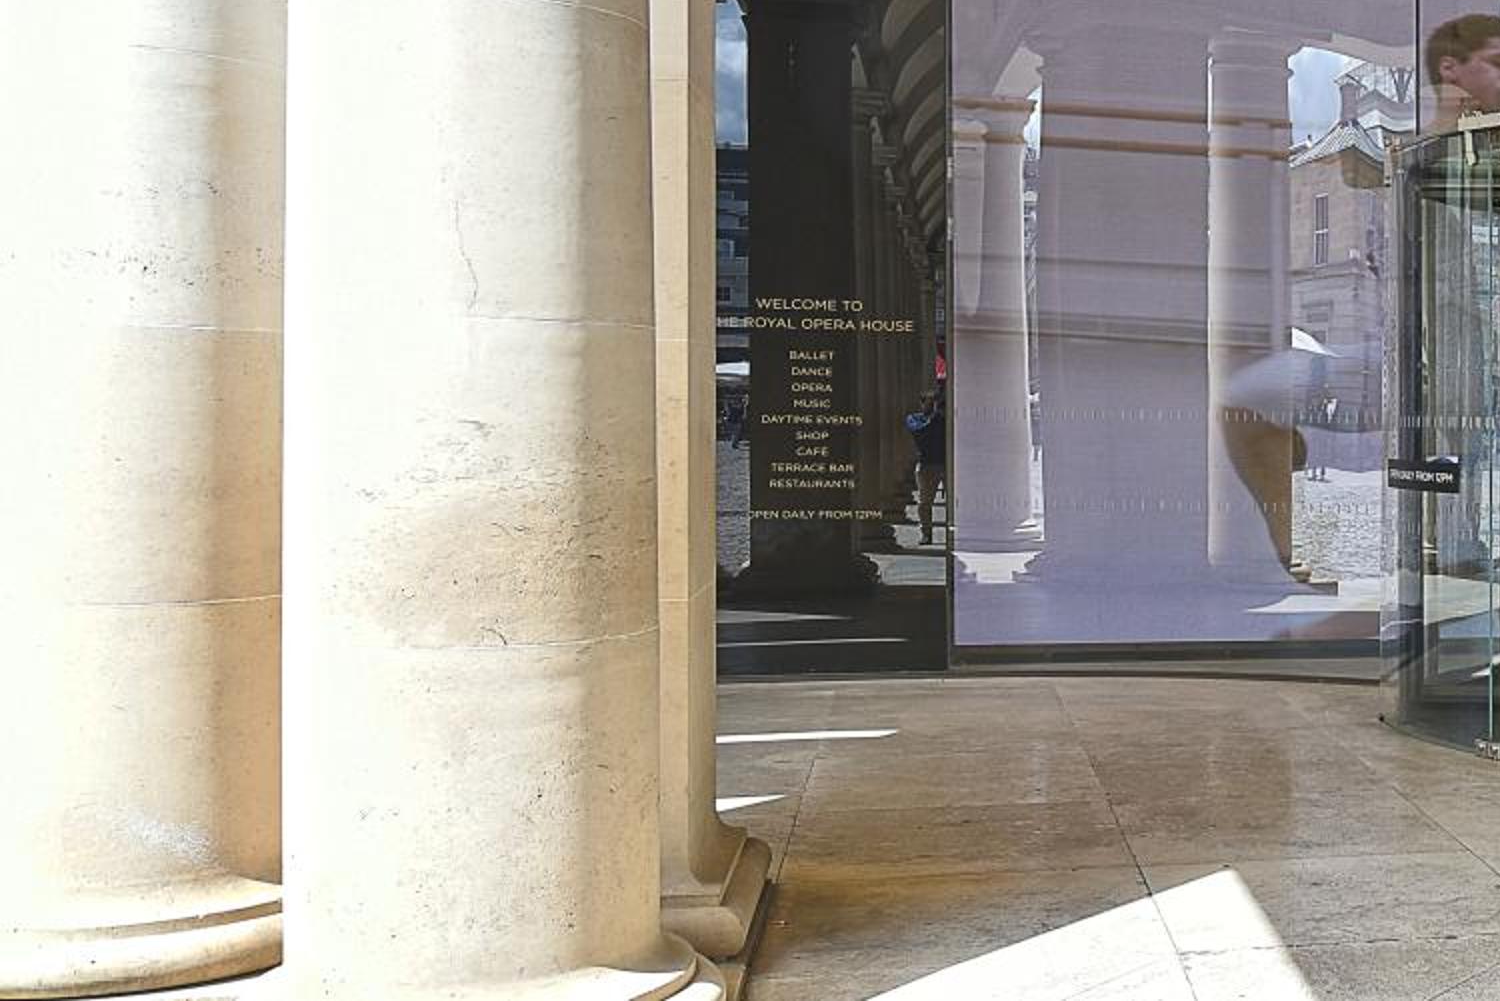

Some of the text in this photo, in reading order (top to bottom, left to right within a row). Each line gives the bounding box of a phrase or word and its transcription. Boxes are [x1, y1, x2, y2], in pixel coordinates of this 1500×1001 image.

[755, 297, 863, 312] WELCOME TO
[743, 316, 797, 330] ROYAL
[801, 317, 857, 331] OPERA
[860, 319, 915, 332] HOUSE
[789, 350, 835, 360] BALLET
[791, 366, 833, 376] DANCE
[791, 382, 833, 393] OPERA
[793, 398, 832, 408] MUSIC
[760, 414, 864, 426] DAYTIME EVENTS
[795, 430, 830, 441] SHOP
[770, 462, 856, 473] TERRACE BAR
[768, 478, 856, 490] RESTAURANTS
[746, 509, 780, 520] OPEN
[781, 510, 816, 520] DAILY
[818, 510, 852, 520] FROM
